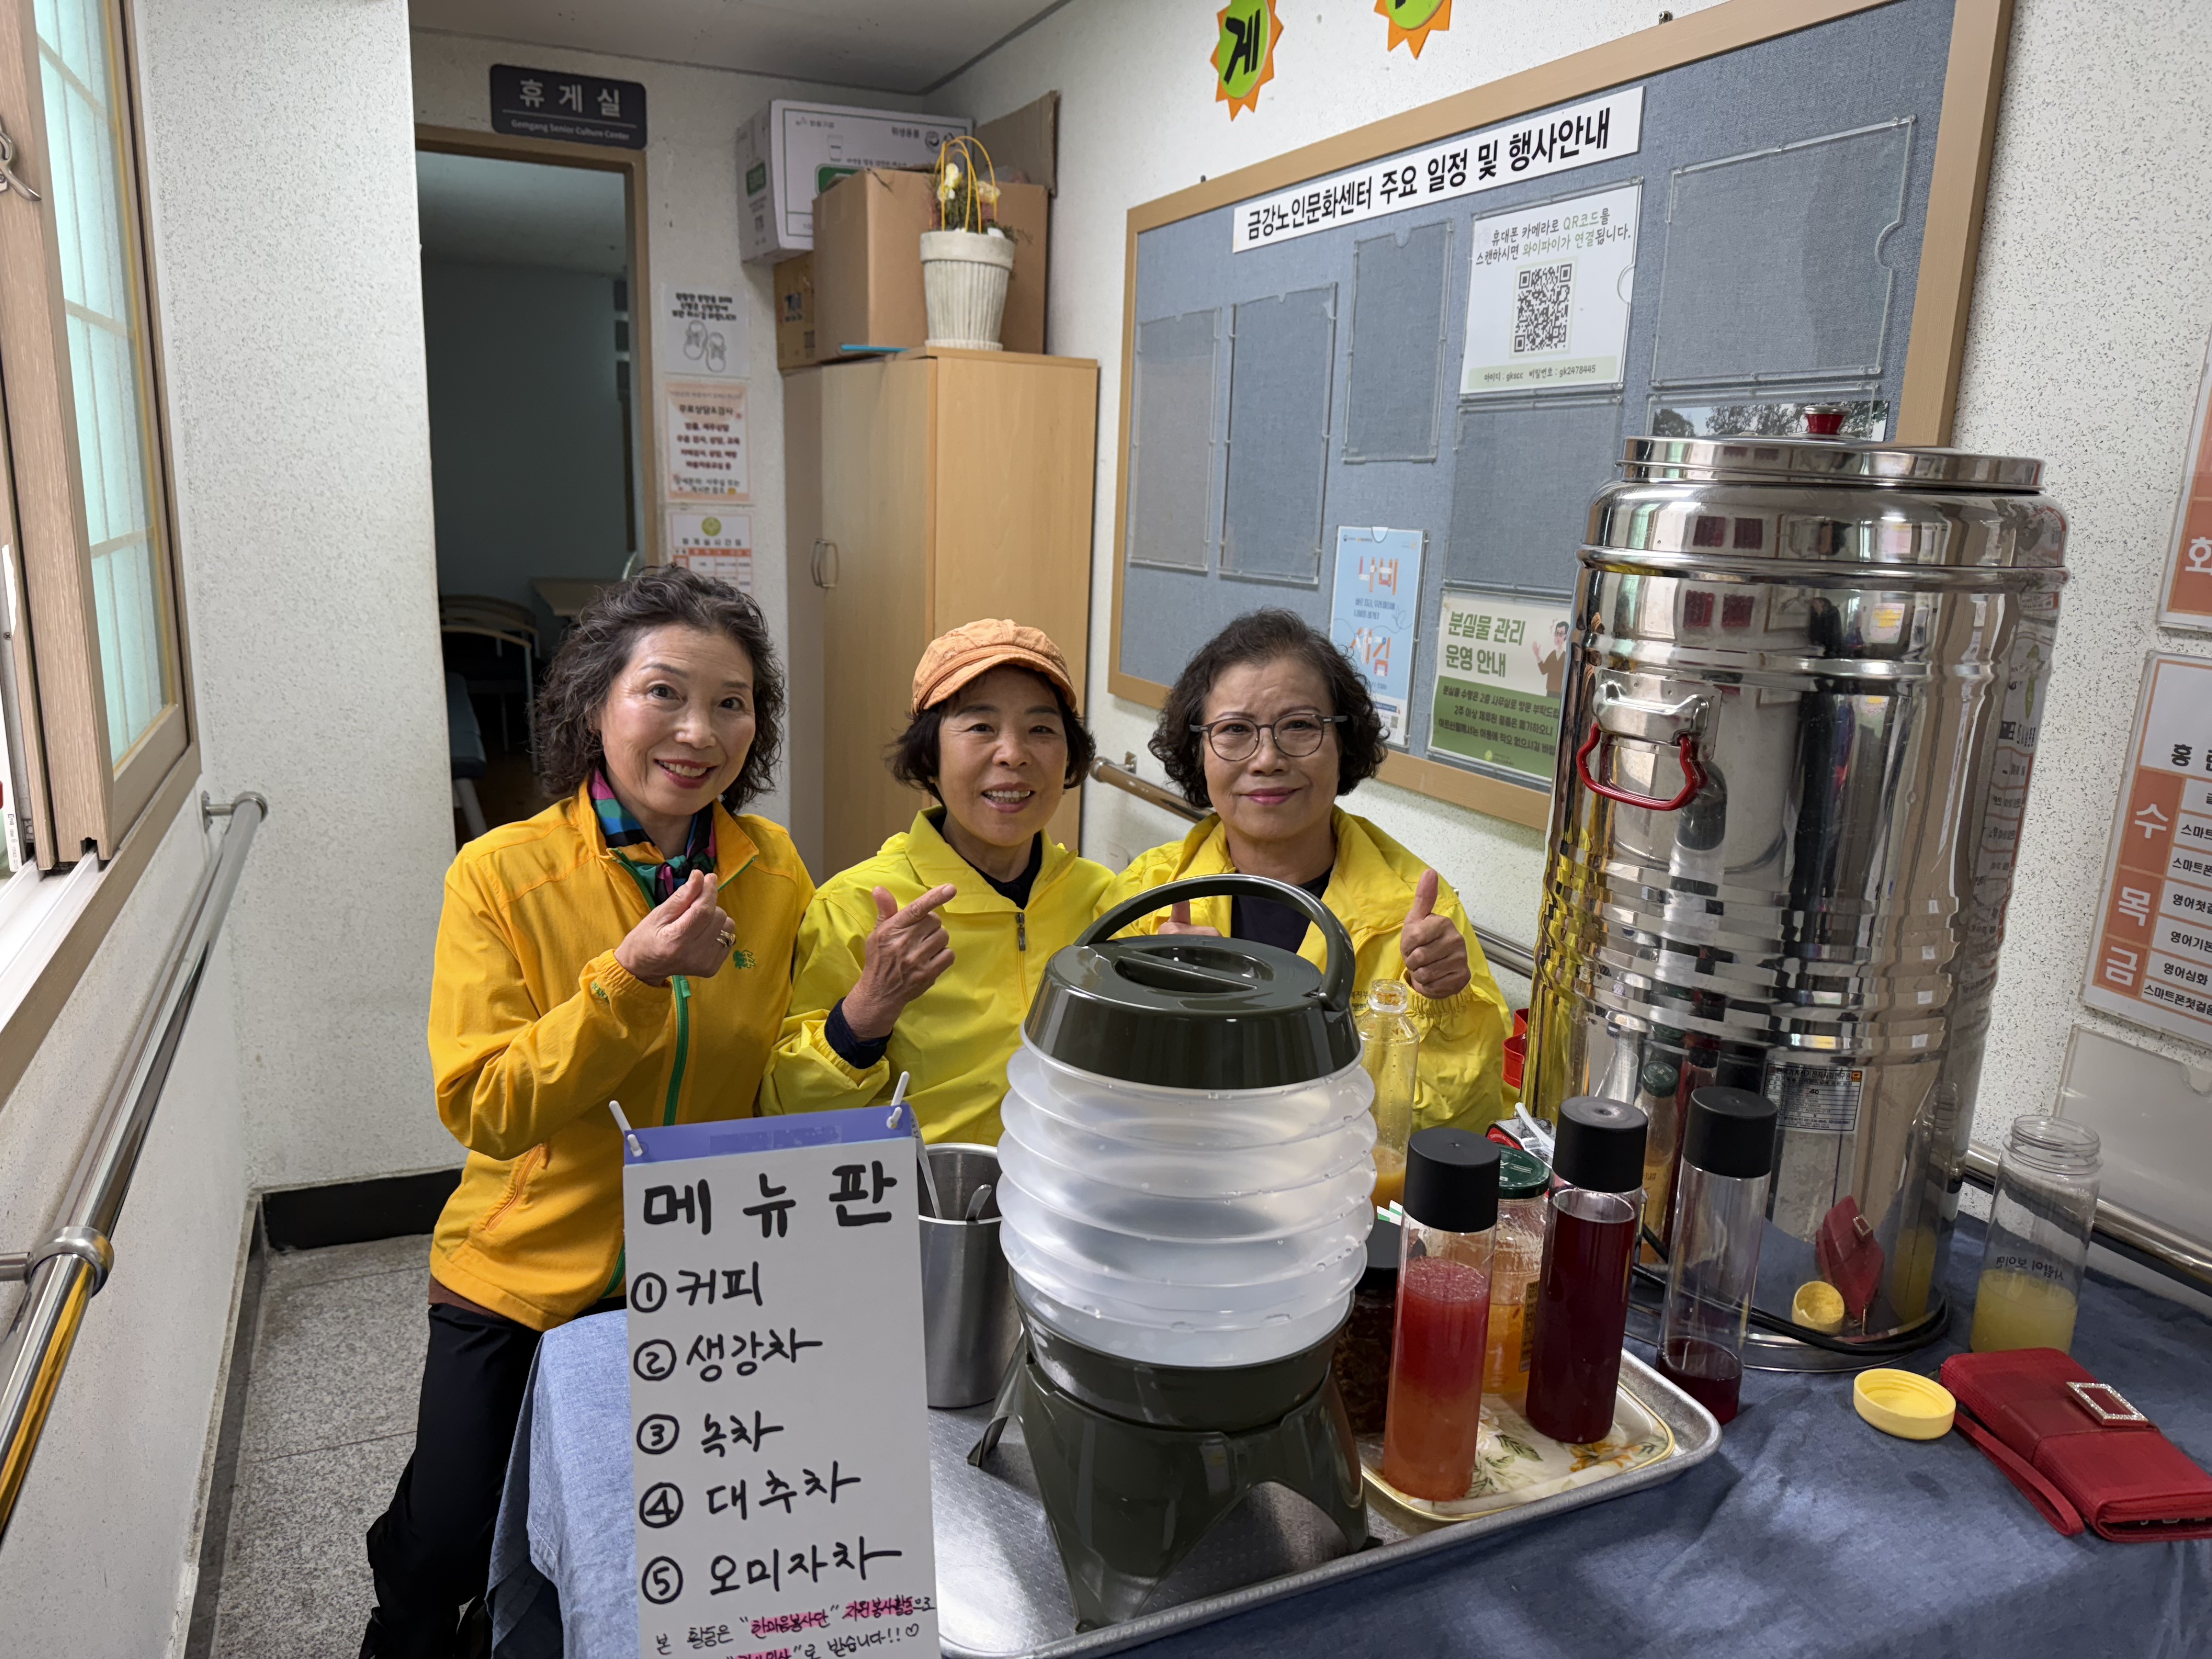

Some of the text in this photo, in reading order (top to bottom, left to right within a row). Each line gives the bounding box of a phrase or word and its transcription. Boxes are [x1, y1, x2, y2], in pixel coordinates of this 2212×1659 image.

[1223, 8, 1260, 84] 게
[604, 129, 630, 140] Center
[1247, 107, 1612, 241] 금강노인문화센터 주요 일정 및 행사안내
[1476, 223, 1631, 266] 스캔하시면 와이파이가 연결됩니다.
[1491, 208, 1610, 246] 휴대폰 카메라로 QR코드를
[1484, 371, 1501, 383] 아이디
[1529, 366, 1553, 379] 비밀번호
[1559, 364, 1596, 376] gk2478445
[1448, 611, 1526, 646] 분실물 관리
[1446, 644, 1506, 678] 운영 안내
[2134, 803, 2169, 839] 수
[2118, 885, 2151, 927] 목
[2105, 945, 2138, 987] 금
[2164, 962, 2208, 986] 영어심화
[643, 1160, 898, 1238] 메뉴판
[676, 1261, 763, 1306] 커피
[686, 1327, 823, 1382] 생강차
[701, 1410, 784, 1457] 녹차
[706, 1460, 861, 1520] 대추차
[710, 1536, 902, 1595] 오미자차
[656, 1633, 672, 1656] 본
[686, 1624, 733, 1649] 활동은
[842, 1594, 936, 1622] 자원봉사활동으로
